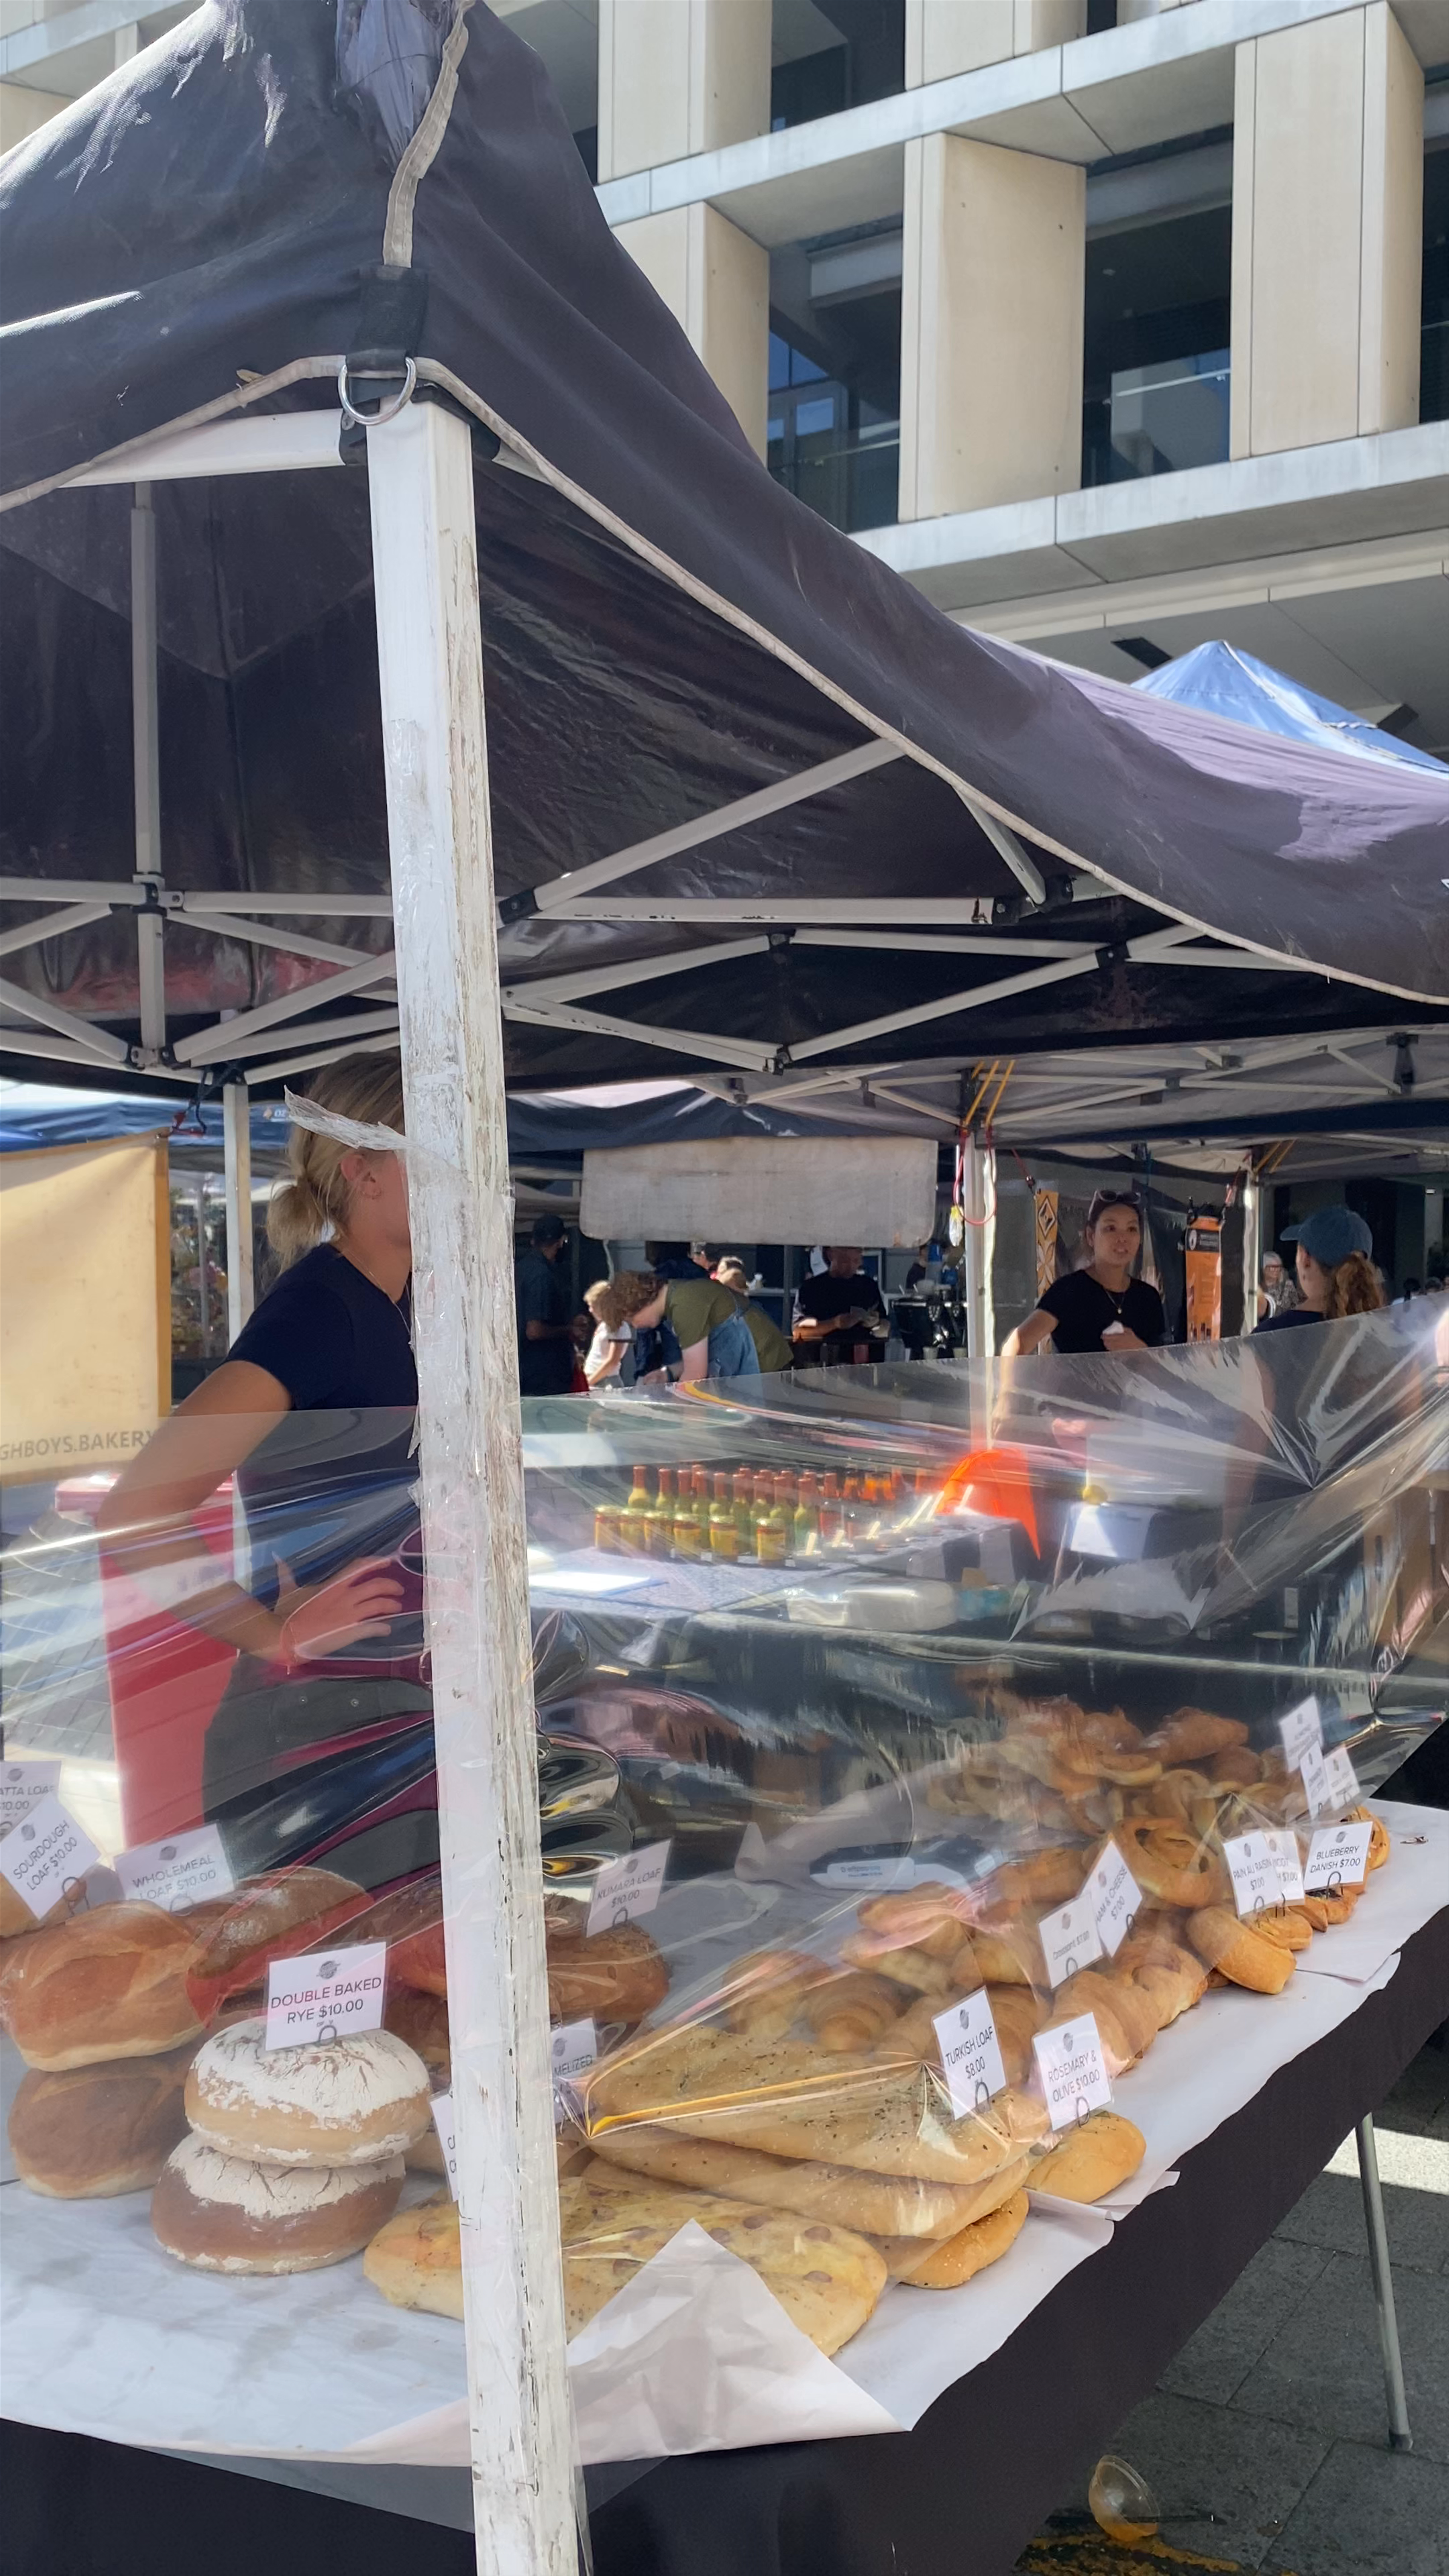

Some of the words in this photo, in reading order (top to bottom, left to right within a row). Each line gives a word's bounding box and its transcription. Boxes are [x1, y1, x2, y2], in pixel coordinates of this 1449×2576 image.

[0, 1801, 29, 1810] 10.00
[13, 1820, 70, 1879] SOURDOUGH
[1316, 1846, 1360, 1860] BLUEBERRY
[26, 1863, 51, 1890] LOAF
[50, 1837, 78, 1867] $10.00
[132, 1855, 215, 1888] WHOLEMEAL
[1233, 1869, 1246, 1880] PAIN
[1310, 1862, 1338, 1873] DANISH
[1340, 1858, 1361, 1868] $7.00
[177, 1870, 216, 1890] $10.00
[637, 1868, 661, 1884] LOAF
[1250, 1877, 1265, 1890] $7.00
[271, 1987, 331, 2009] DOUBLE
[334, 1977, 381, 1996] BAKED
[287, 2008, 315, 2024] RYE
[318, 1999, 363, 2018] $10.00
[945, 2039, 976, 2066] TURKISH
[975, 2026, 993, 2050] LOAF
[965, 2056, 985, 2079] $8.00
[1048, 2053, 1089, 2082] ROSEMARY
[1092, 2050, 1097, 2062] &
[1052, 2082, 1076, 2102] OLIVE
[1075, 2069, 1100, 2091] $10.00
